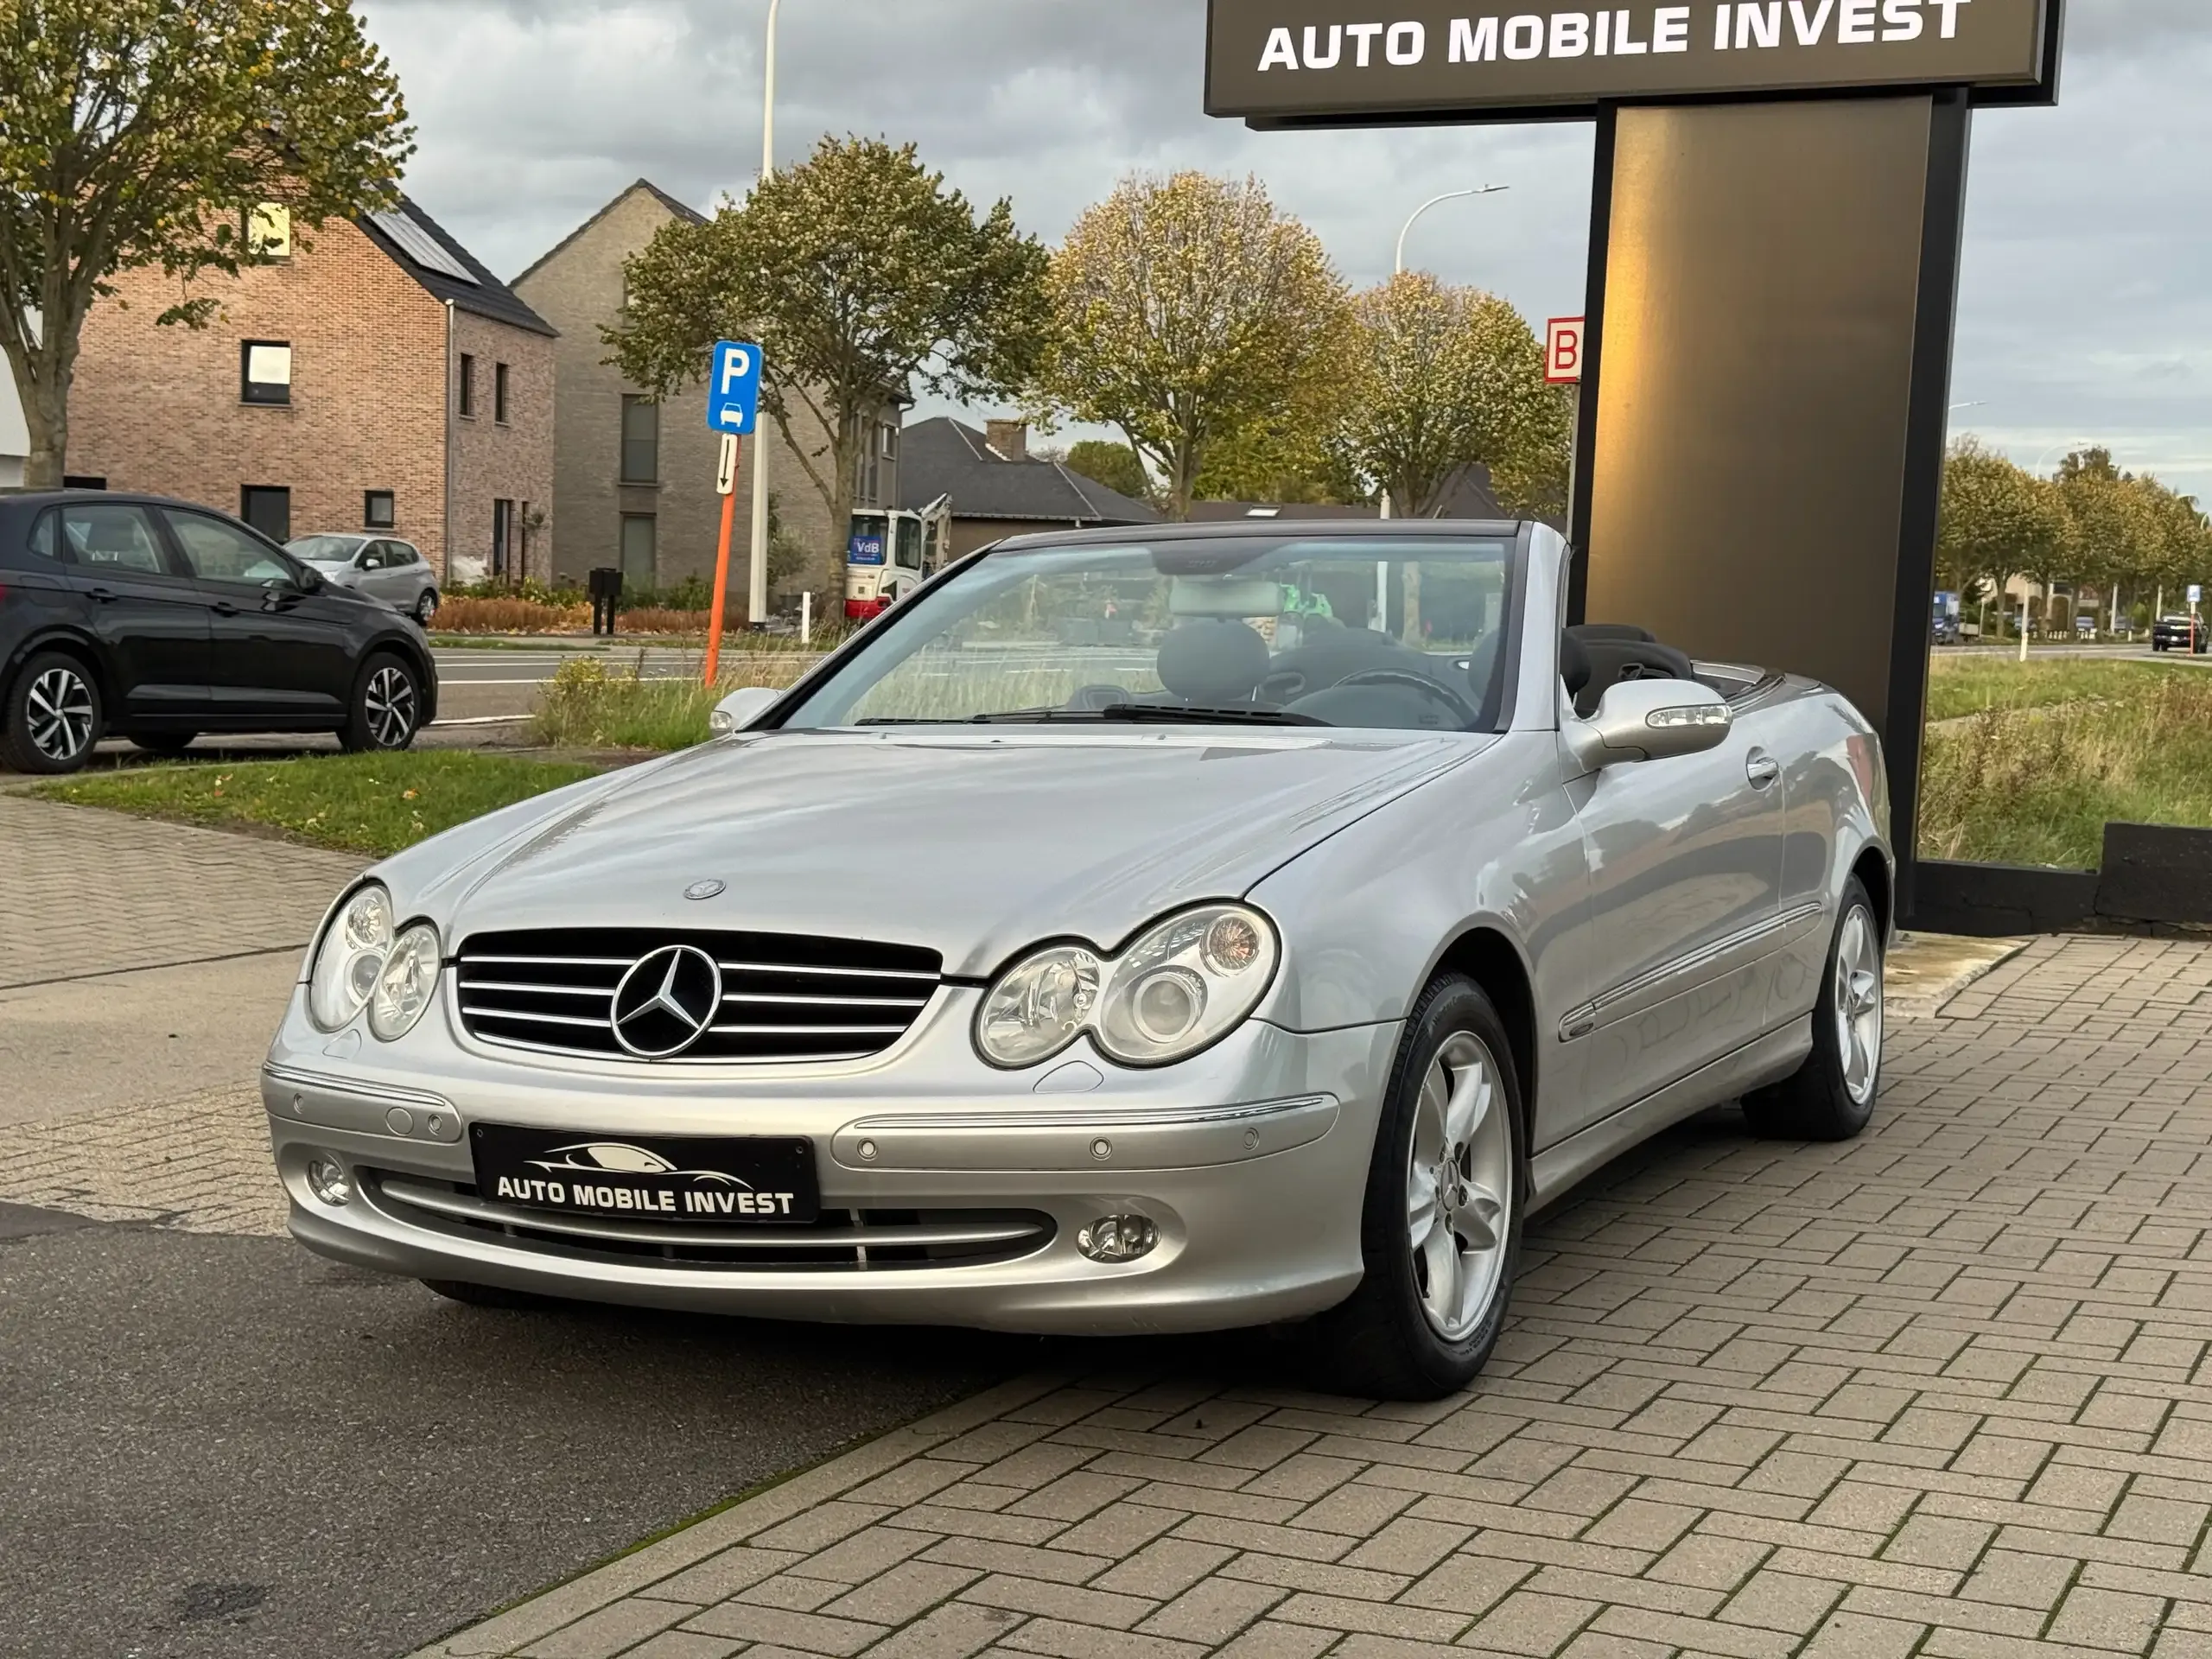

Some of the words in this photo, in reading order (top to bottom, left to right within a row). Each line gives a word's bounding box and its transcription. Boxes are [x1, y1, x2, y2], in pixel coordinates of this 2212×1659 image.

[1257, 21, 1426, 72] AUTO
[1448, 7, 1690, 63] MOBILE
[1713, 0, 1972, 50] INVEST
[1555, 330, 1578, 370] B
[721, 347, 750, 395] P
[857, 542, 880, 553] VdB
[497, 1176, 566, 1204] AUTO
[573, 1185, 677, 1212] MOBILE
[685, 1191, 794, 1215] INVEST
